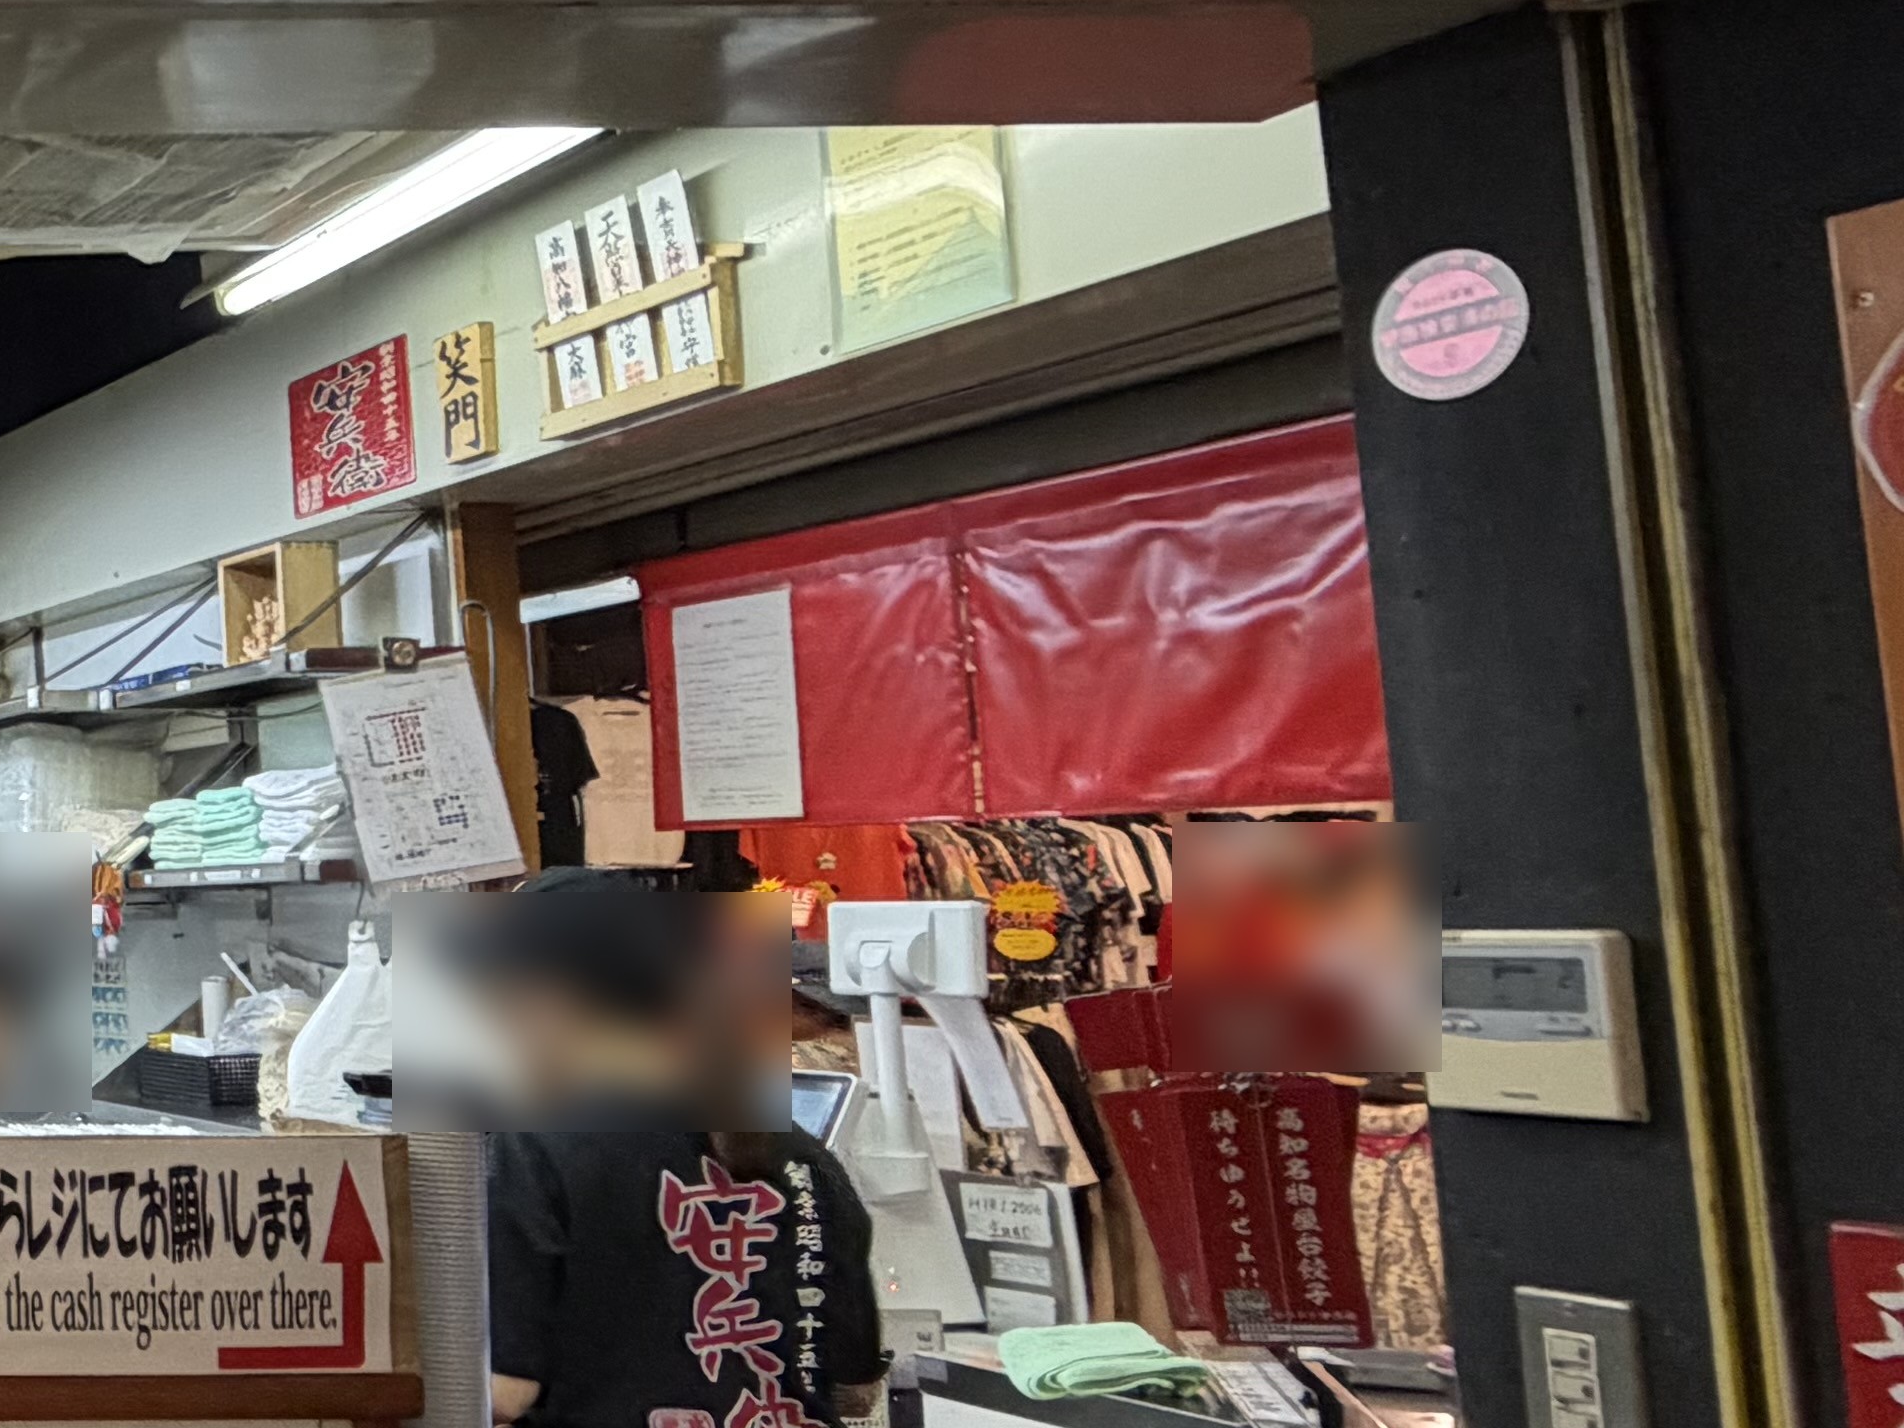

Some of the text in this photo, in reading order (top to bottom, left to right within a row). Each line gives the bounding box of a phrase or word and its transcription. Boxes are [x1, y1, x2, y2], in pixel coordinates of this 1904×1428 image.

[439, 330, 481, 459] 笑門
[4, 1272, 46, 1334] the
[51, 1272, 106, 1334] cash
[110, 1275, 205, 1351] register
[210, 1286, 266, 1334] over
[270, 1272, 340, 1334] there.
